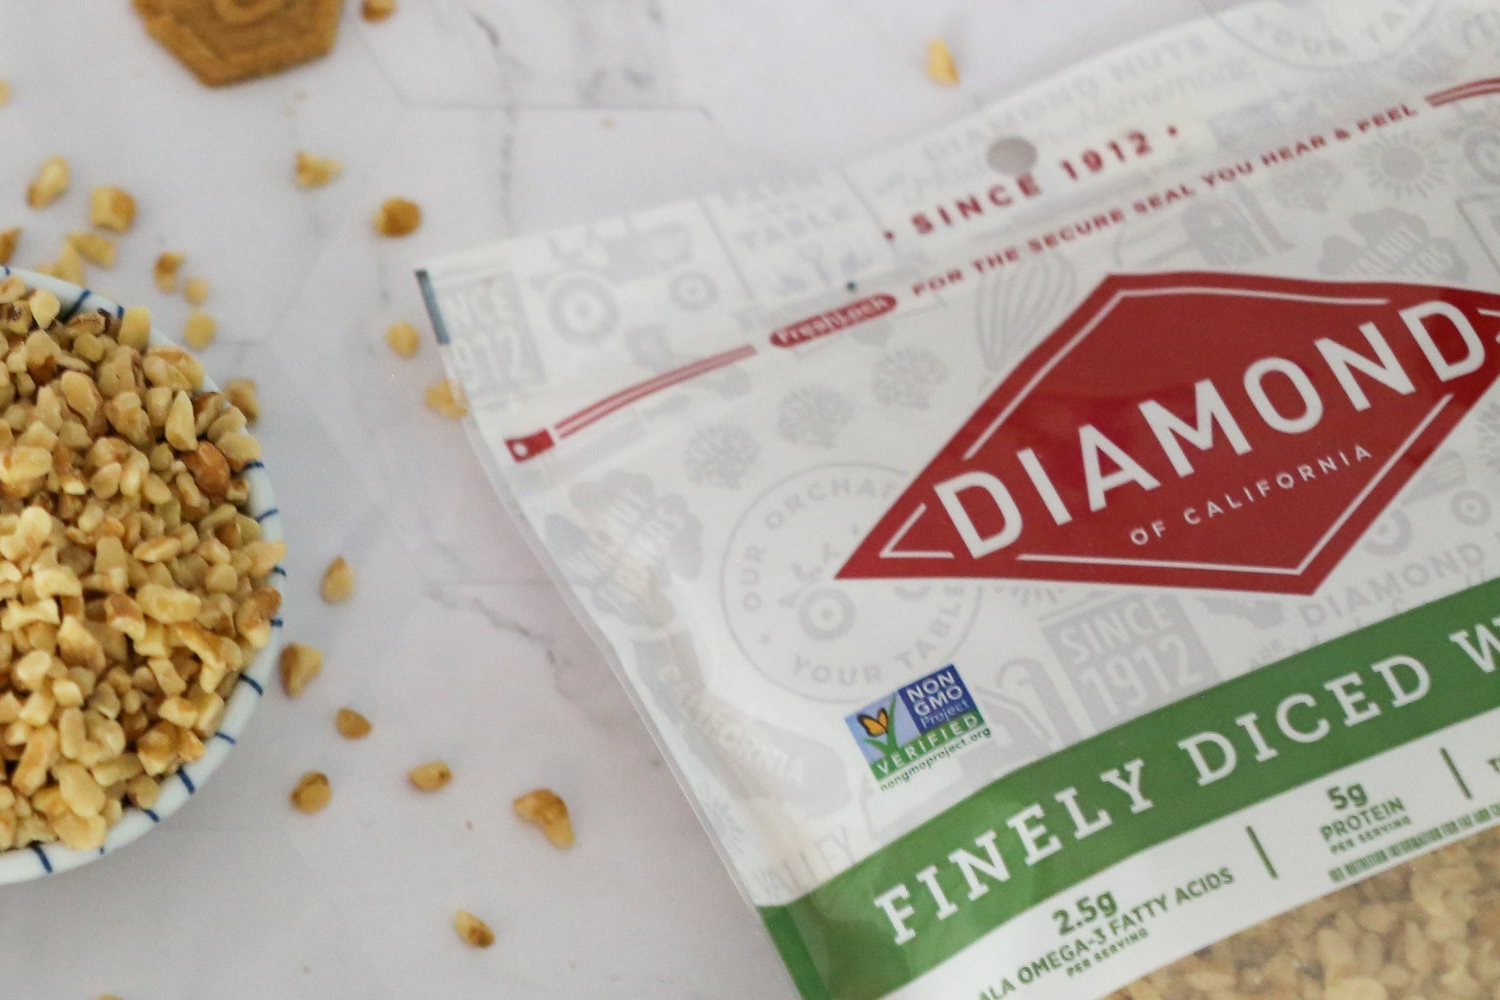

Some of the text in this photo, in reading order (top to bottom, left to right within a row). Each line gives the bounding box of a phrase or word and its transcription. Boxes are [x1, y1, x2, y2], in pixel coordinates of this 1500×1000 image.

[909, 173, 1044, 237] SINCE
[1060, 129, 1154, 182] 1912
[911, 269, 964, 297] FOR
[973, 247, 1021, 276] THE
[1027, 209, 1127, 253] SECURE
[1133, 184, 1194, 215] SEAL
[1201, 160, 1254, 188] YOU
[1262, 135, 1328, 168] HEAR
[1357, 103, 1418, 134] FEEL
[934, 300, 1487, 560] DIAMOND
[1129, 443, 1373, 546] OF CALIFORNIA
[1060, 593, 1170, 665] SINCE
[905, 671, 956, 703] NON
[914, 685, 964, 716] GMO
[1078, 633, 1204, 718] 1912
[876, 714, 978, 776] VERIFIED
[918, 698, 971, 729] Project
[880, 727, 991, 792] nongmoproject.org
[872, 758, 1155, 944] FINELY
[1177, 654, 1431, 785] DICED
[1318, 796, 1406, 842] PROTEIN
[1326, 783, 1369, 811] 5g
[1329, 816, 1412, 854] PER SERVING
[1016, 926, 1108, 985] OMEGA-3
[1108, 894, 1170, 937] FATTY
[1173, 867, 1235, 905] ACIDS
[1052, 891, 1118, 936] 2.5g
[1066, 927, 1150, 977] PER SERVING
